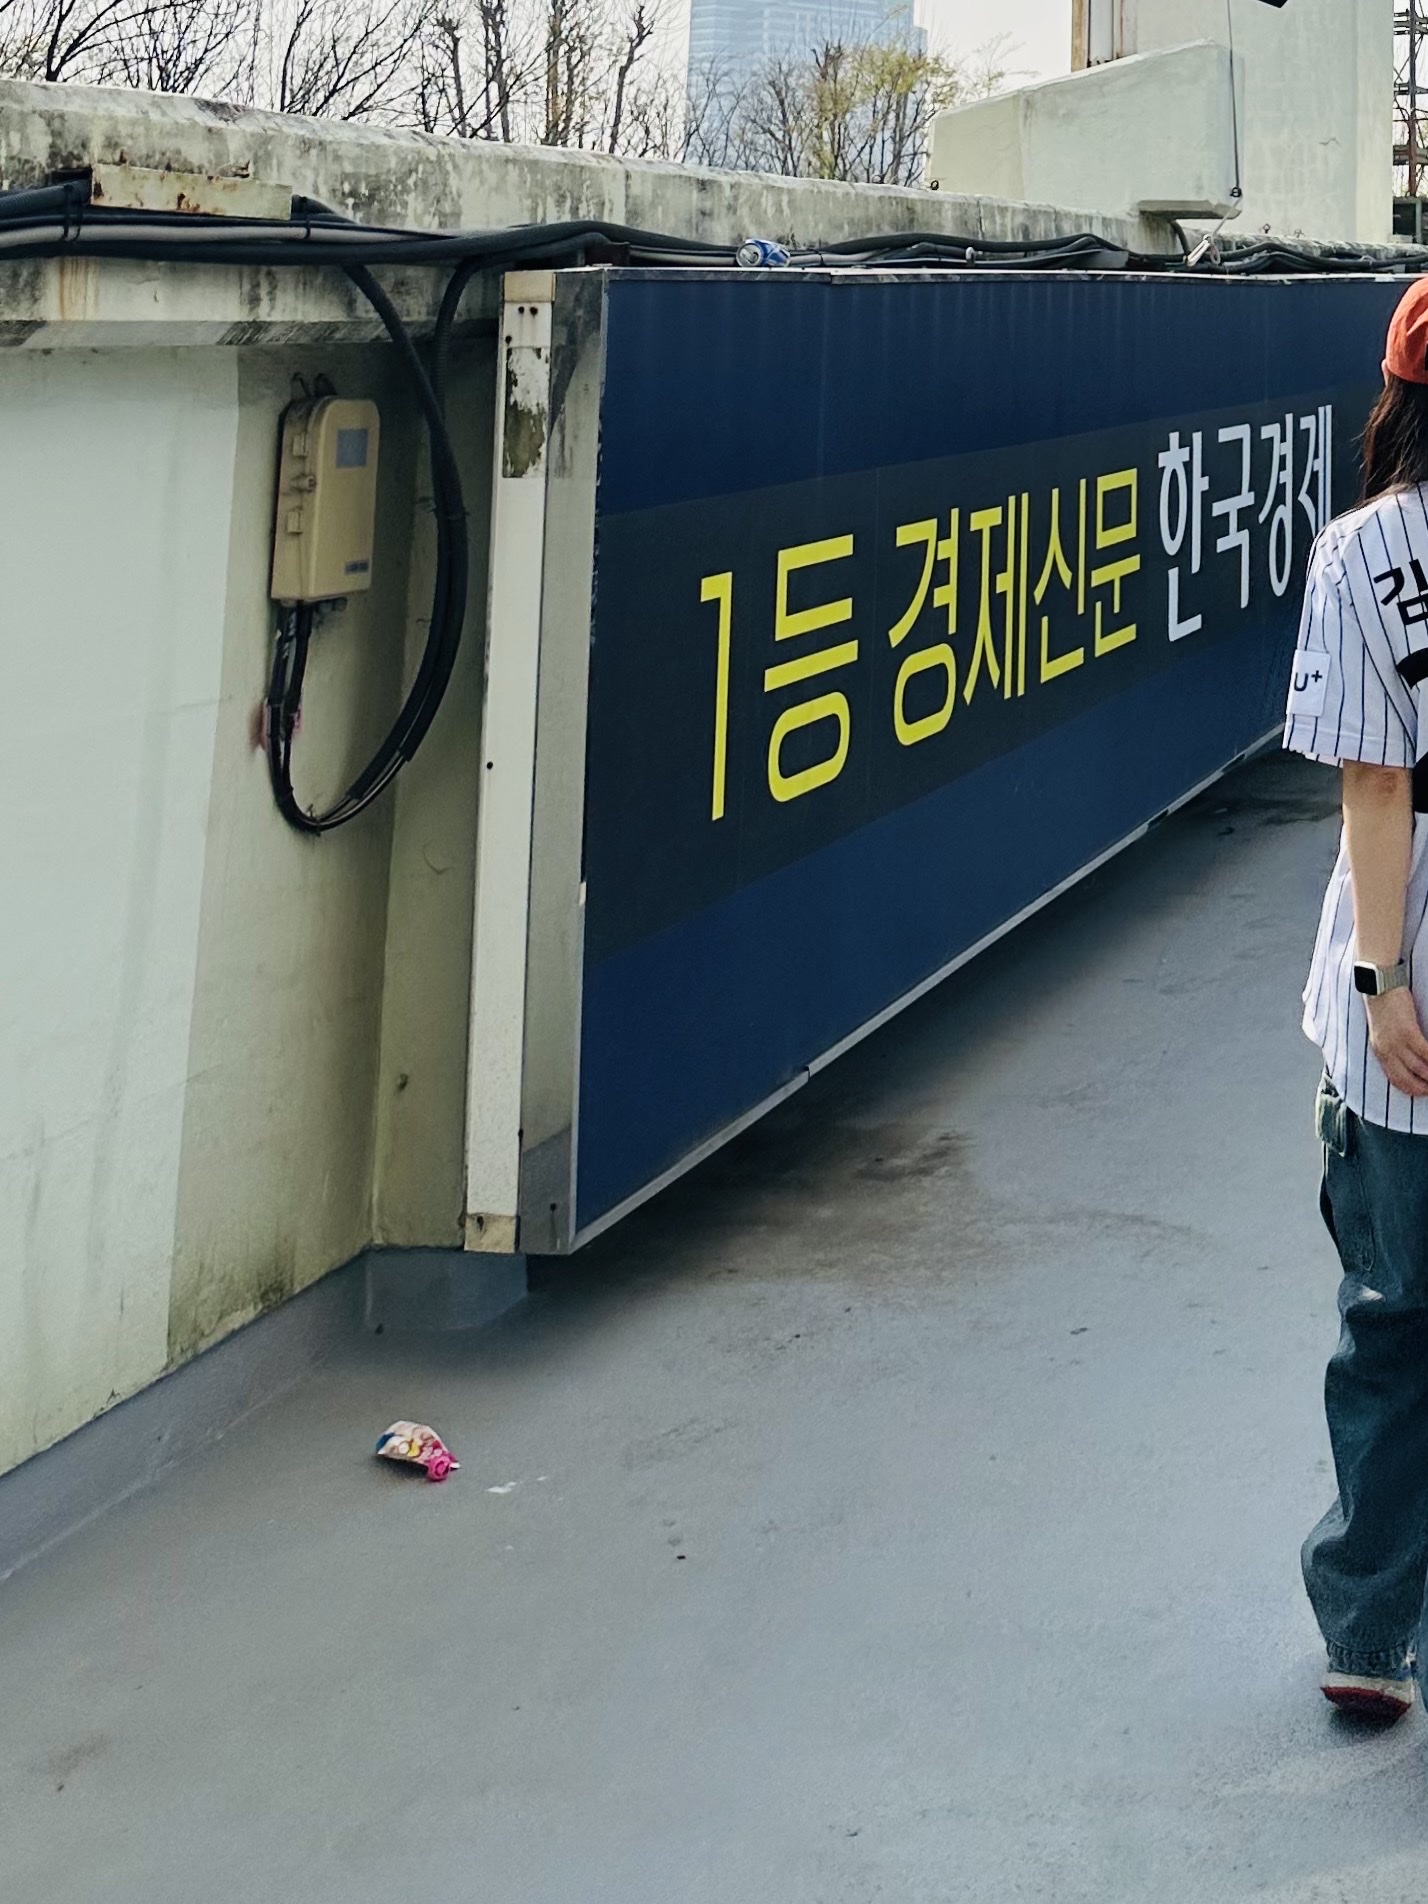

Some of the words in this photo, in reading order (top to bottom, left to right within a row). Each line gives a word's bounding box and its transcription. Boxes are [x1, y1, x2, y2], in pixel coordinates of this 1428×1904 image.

[700, 533, 860, 822] 1등
[888, 467, 1141, 746] 경제신문
[1157, 403, 1333, 643] 한국경제
[1293, 669, 1323, 692] U+
